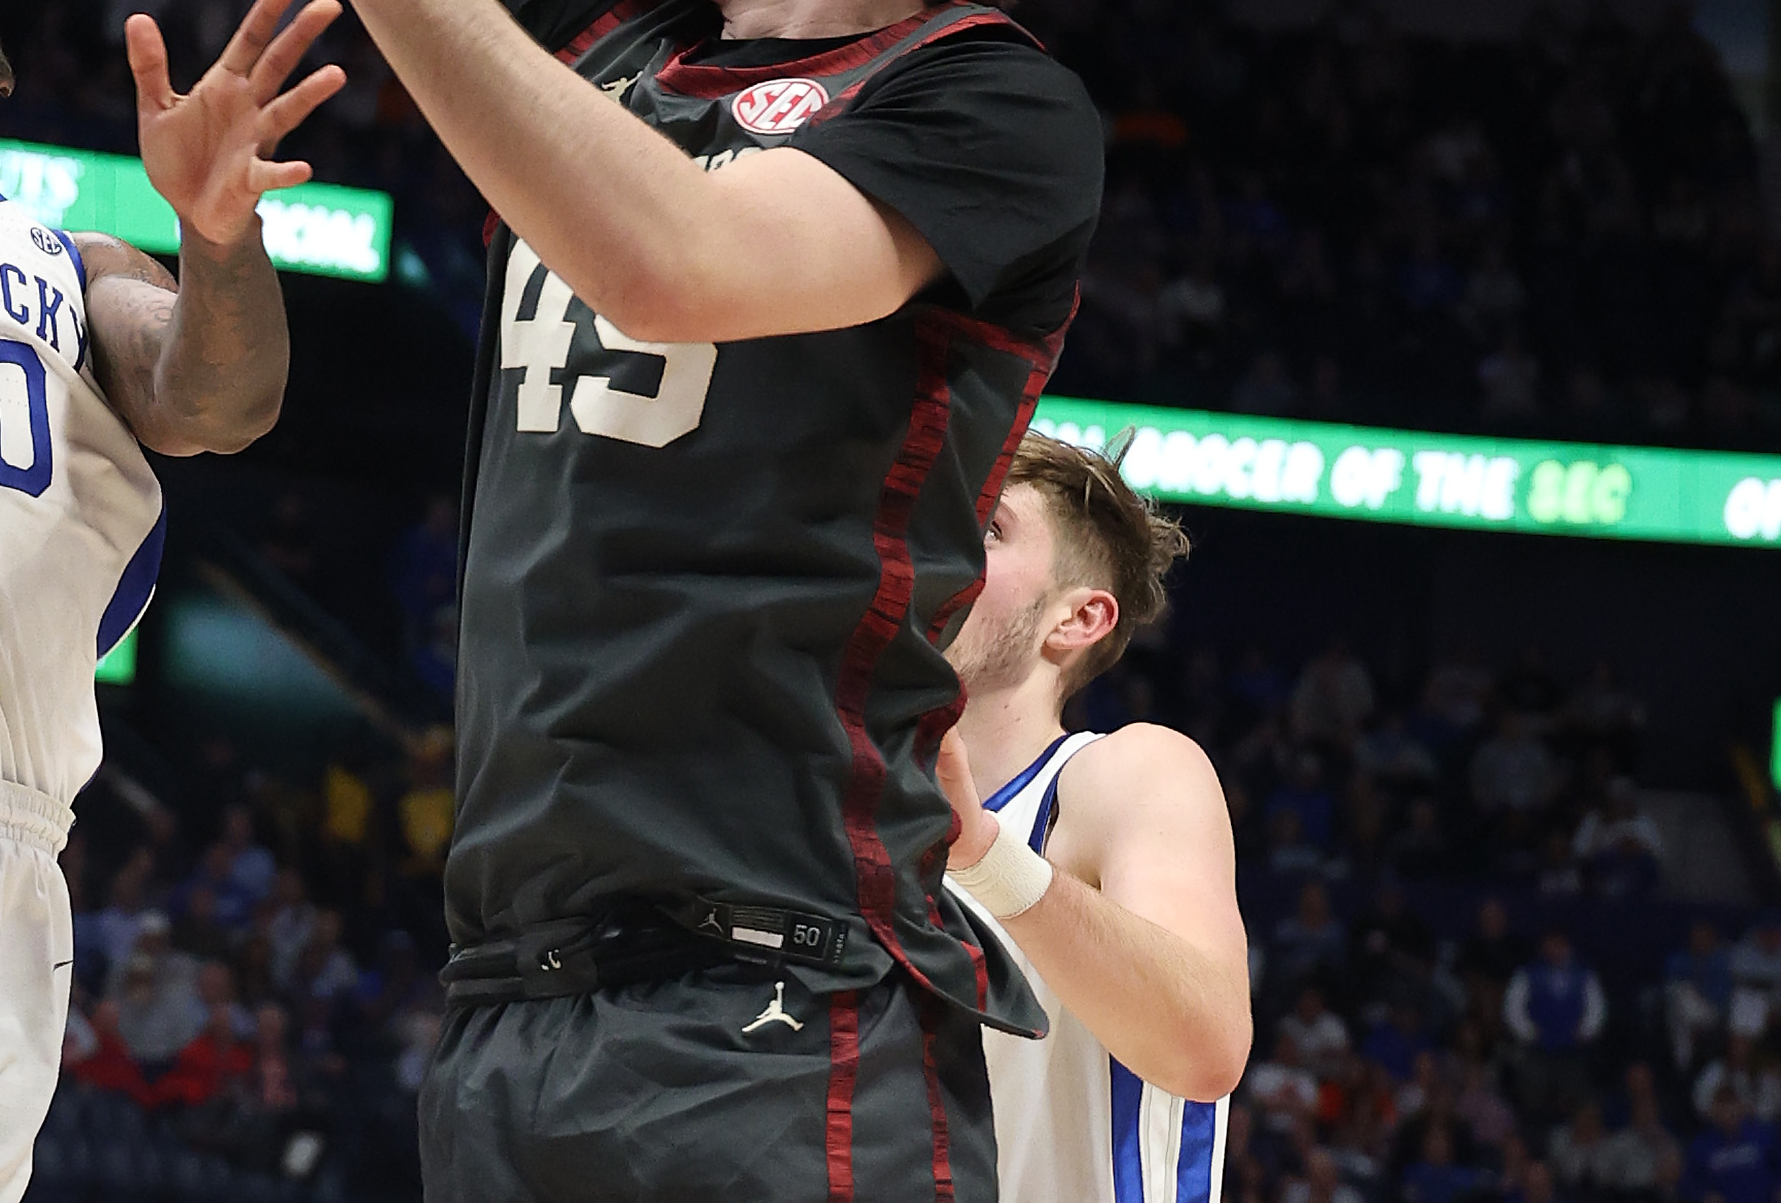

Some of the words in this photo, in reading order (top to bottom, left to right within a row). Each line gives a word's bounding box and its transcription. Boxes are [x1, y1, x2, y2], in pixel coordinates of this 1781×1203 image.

[734, 81, 825, 133] SEC
[31, 228, 62, 255] SEC
[1330, 445, 1406, 509] OF
[1412, 450, 1519, 521] THE
[794, 924, 820, 946] 50
